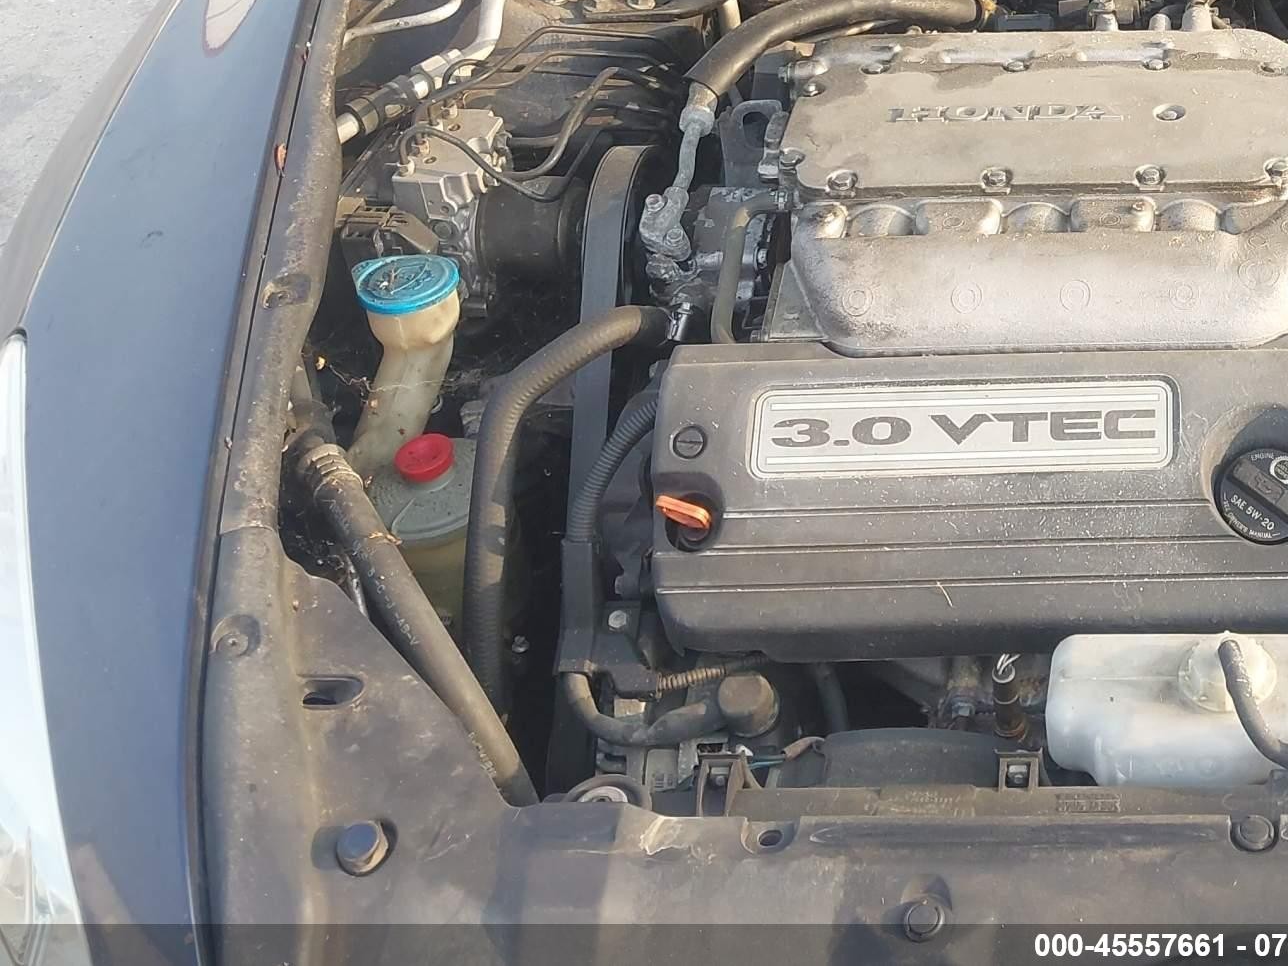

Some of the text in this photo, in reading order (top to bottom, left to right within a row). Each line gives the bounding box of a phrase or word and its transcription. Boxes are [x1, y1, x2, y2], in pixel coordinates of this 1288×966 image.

[886, 104, 1124, 123] HONDA
[771, 409, 1156, 447] 3.0 VTEC
[1251, 452, 1275, 461] ENGINE
[1231, 494, 1275, 531] SAE 5W-20
